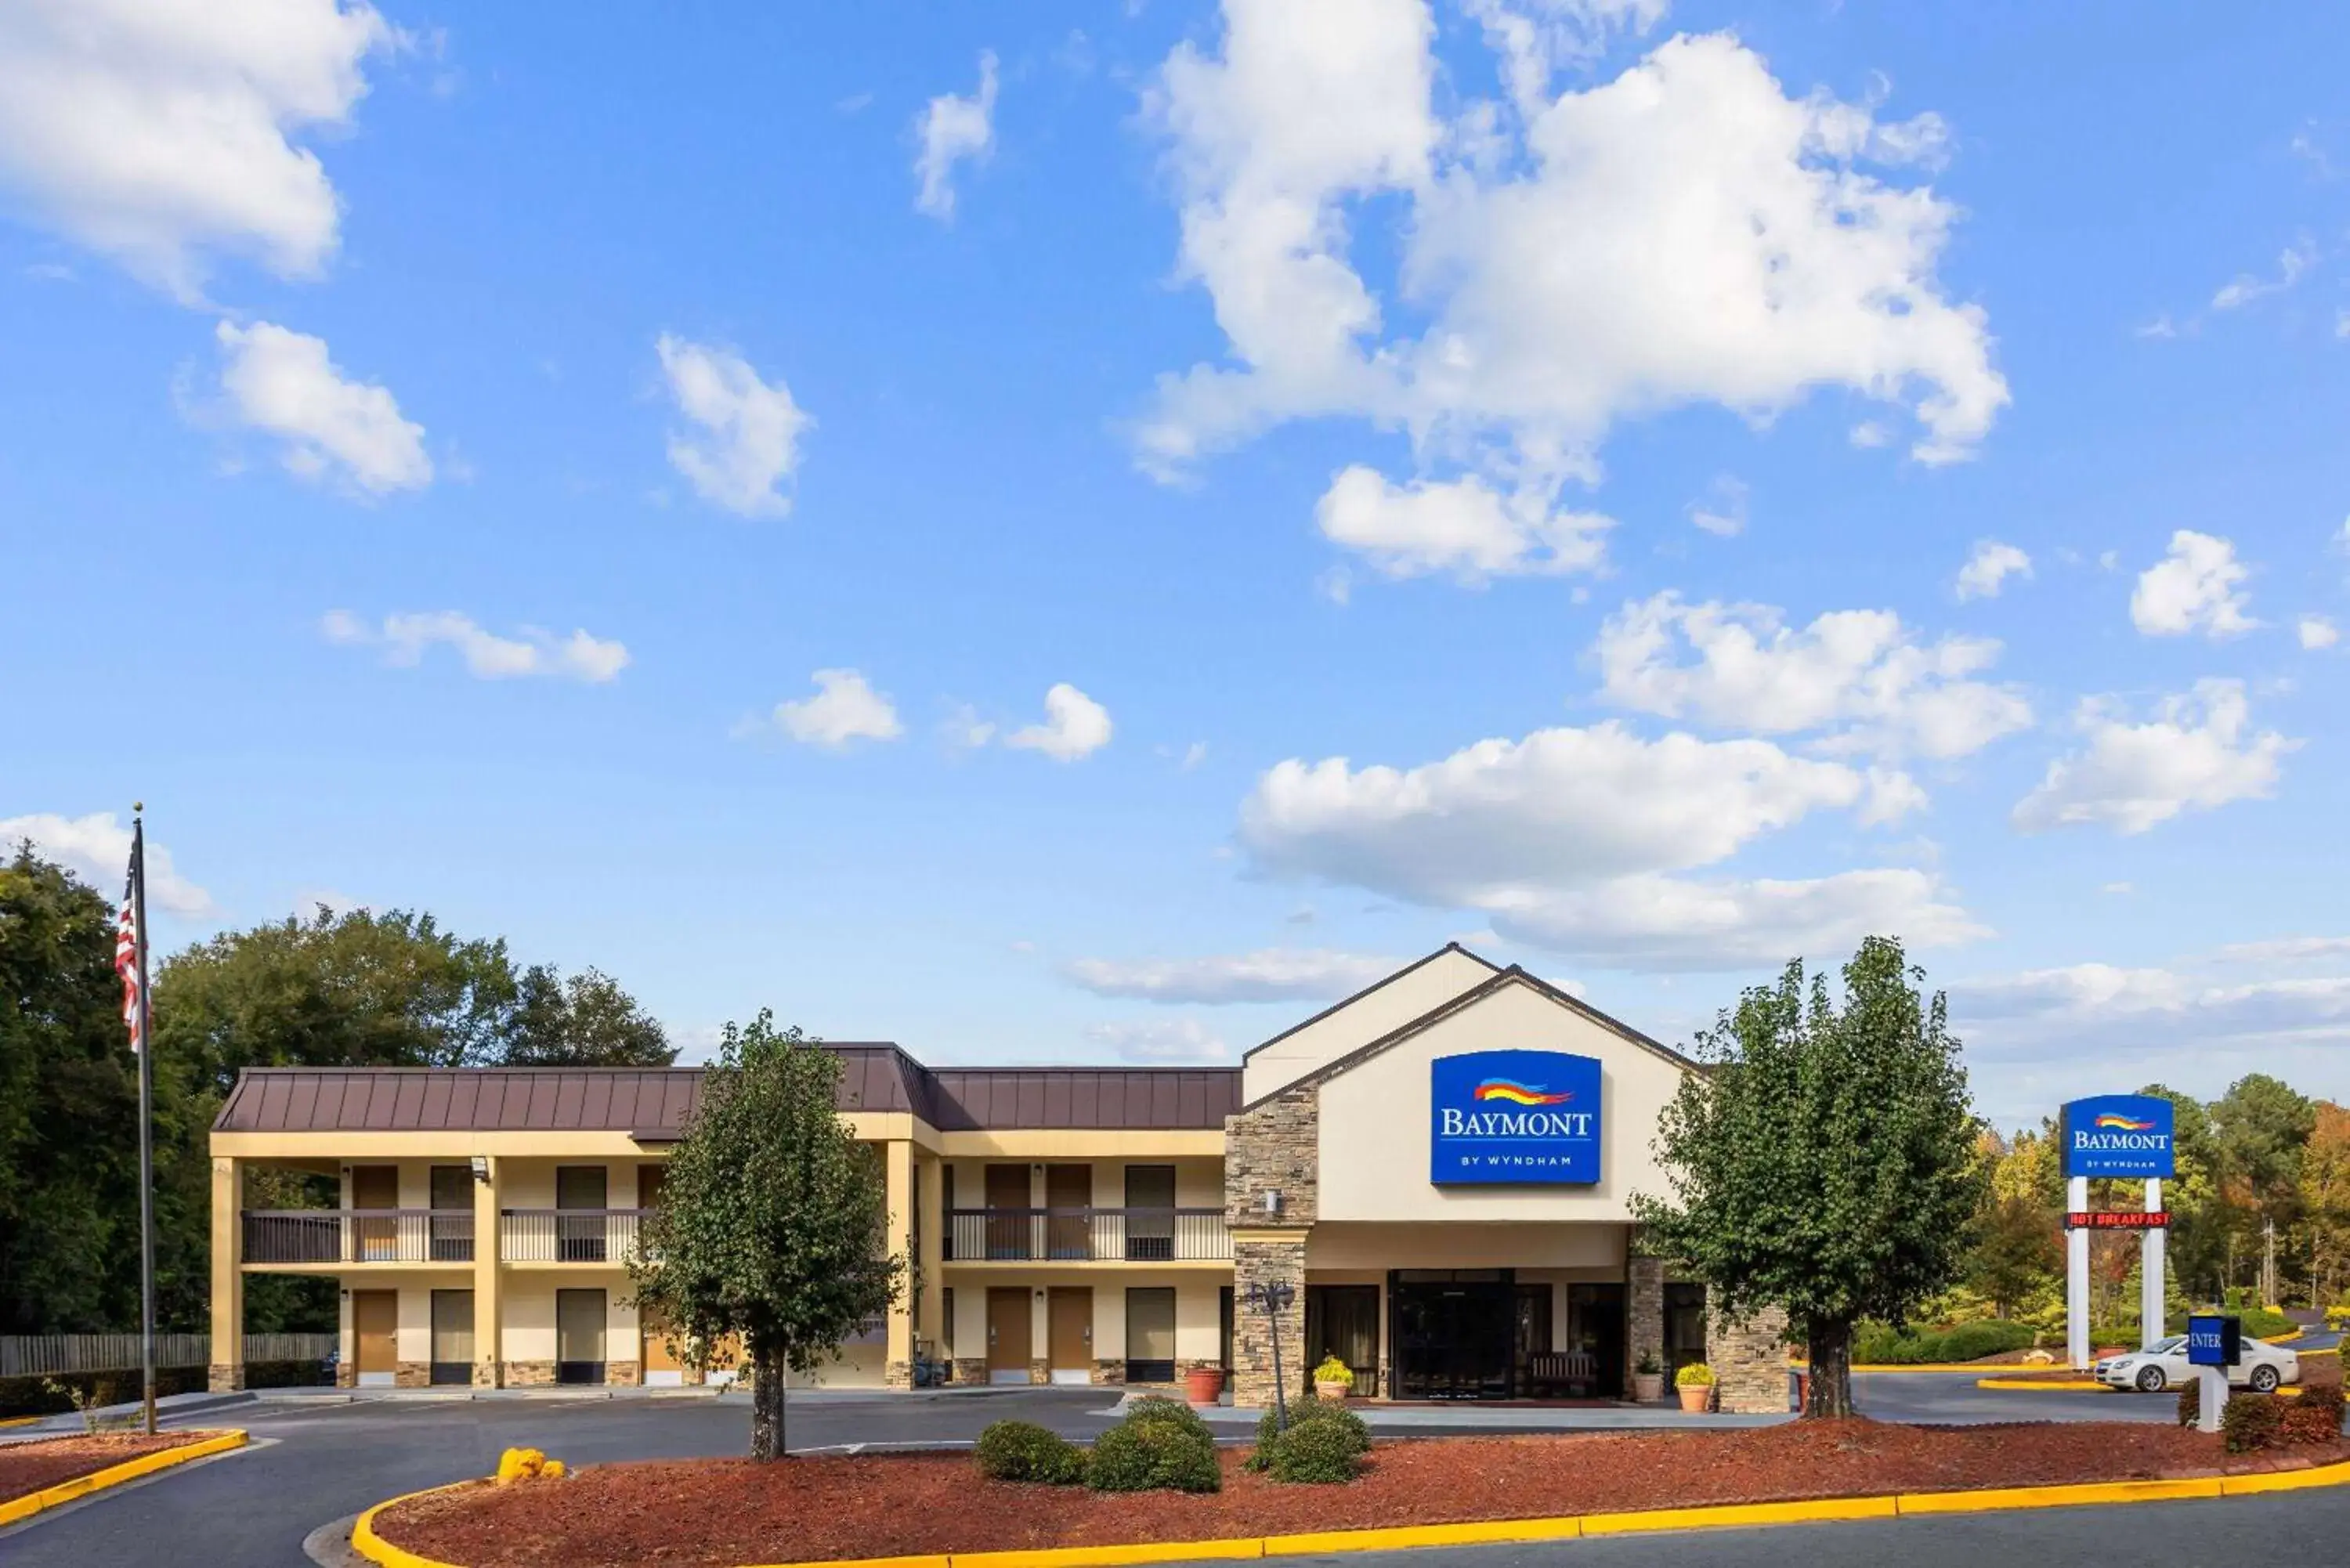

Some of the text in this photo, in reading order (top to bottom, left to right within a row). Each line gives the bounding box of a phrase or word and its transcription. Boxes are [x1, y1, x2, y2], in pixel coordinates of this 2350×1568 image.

[1441, 1108, 1592, 1136] BAYMONT
[2074, 1130, 2169, 1149] BAYMONT
[1462, 1156, 1571, 1166] BY WYNDHAM
[2070, 1214, 2170, 1225] HOT BREAKFAST
[2190, 1333, 2221, 1348] ENTER
